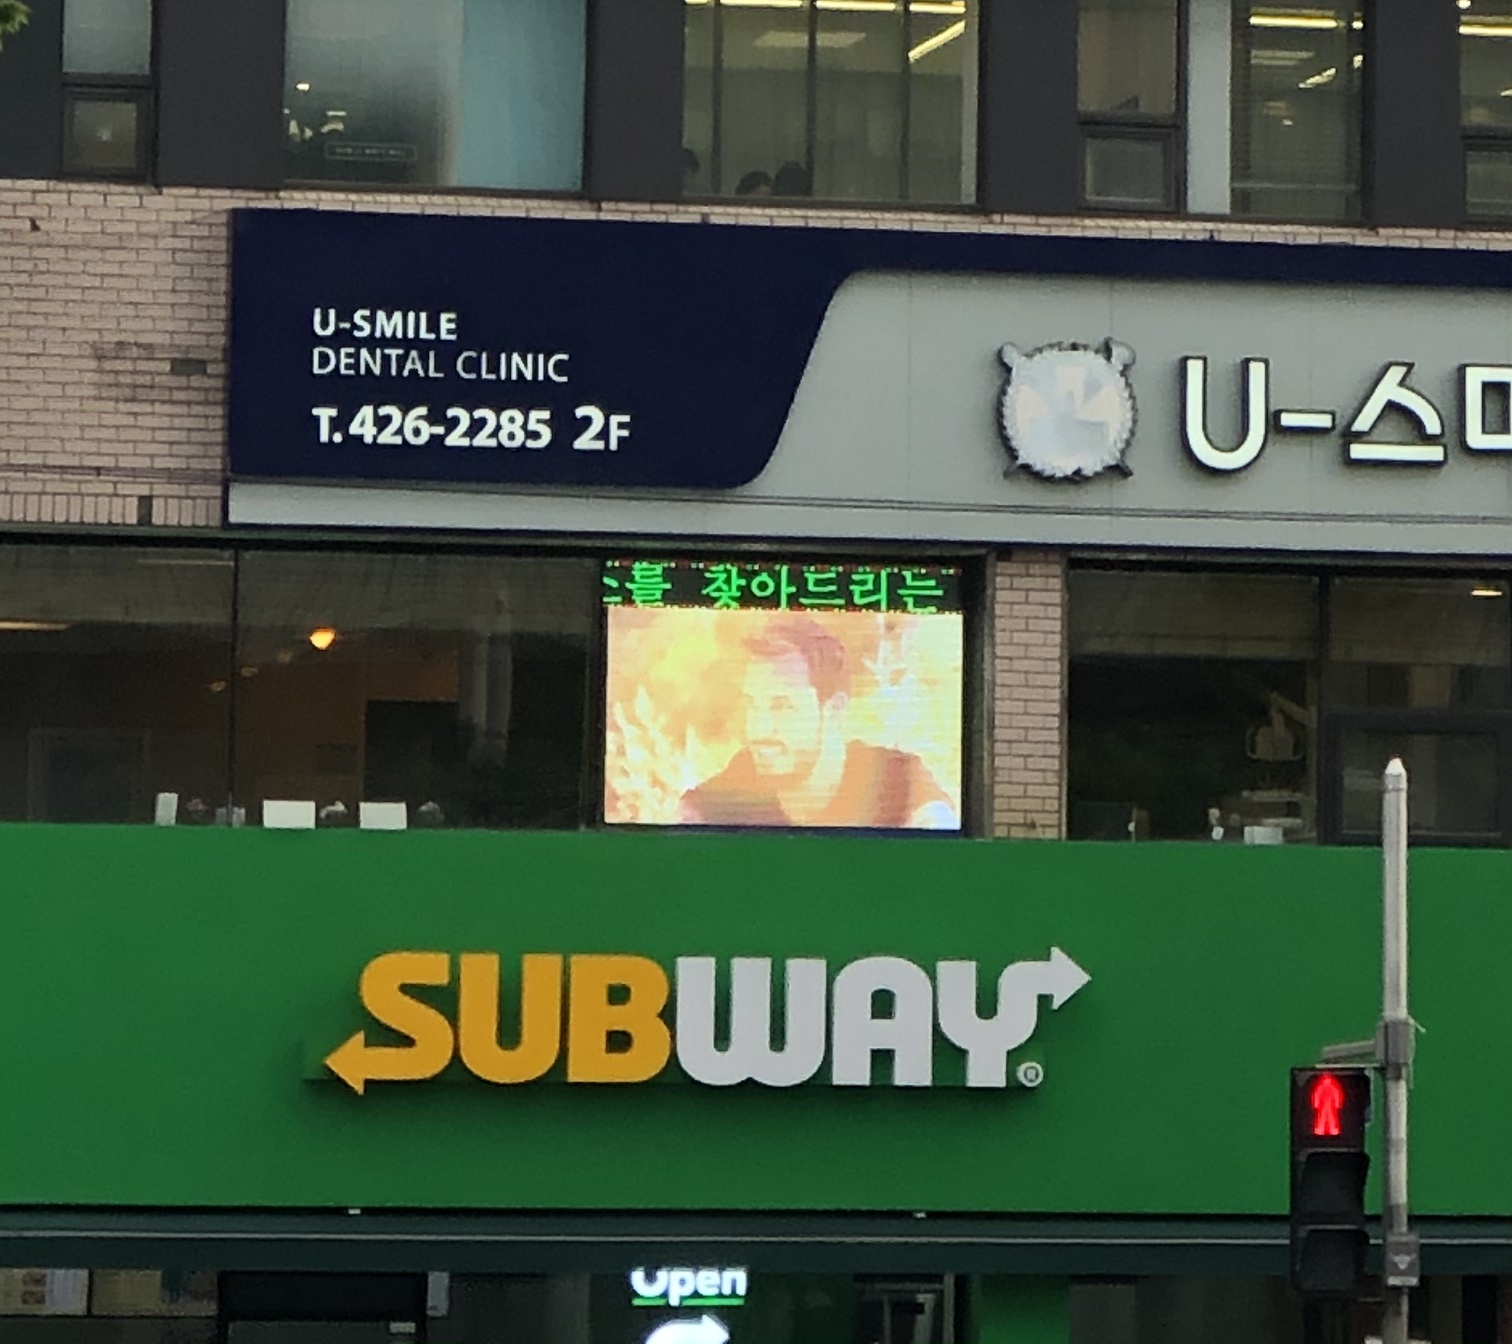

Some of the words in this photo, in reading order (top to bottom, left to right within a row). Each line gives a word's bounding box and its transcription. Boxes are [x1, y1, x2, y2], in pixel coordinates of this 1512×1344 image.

[312, 307, 458, 341] U-SMILE
[311, 346, 445, 378] DENTAL
[456, 350, 571, 383] CLINIC
[311, 404, 553, 449] T.426-2285
[572, 404, 632, 451] 2F
[701, 562, 944, 614] 찾아드리는
[323, 947, 1093, 1096] SUBWAY
[631, 1265, 748, 1307] Open
